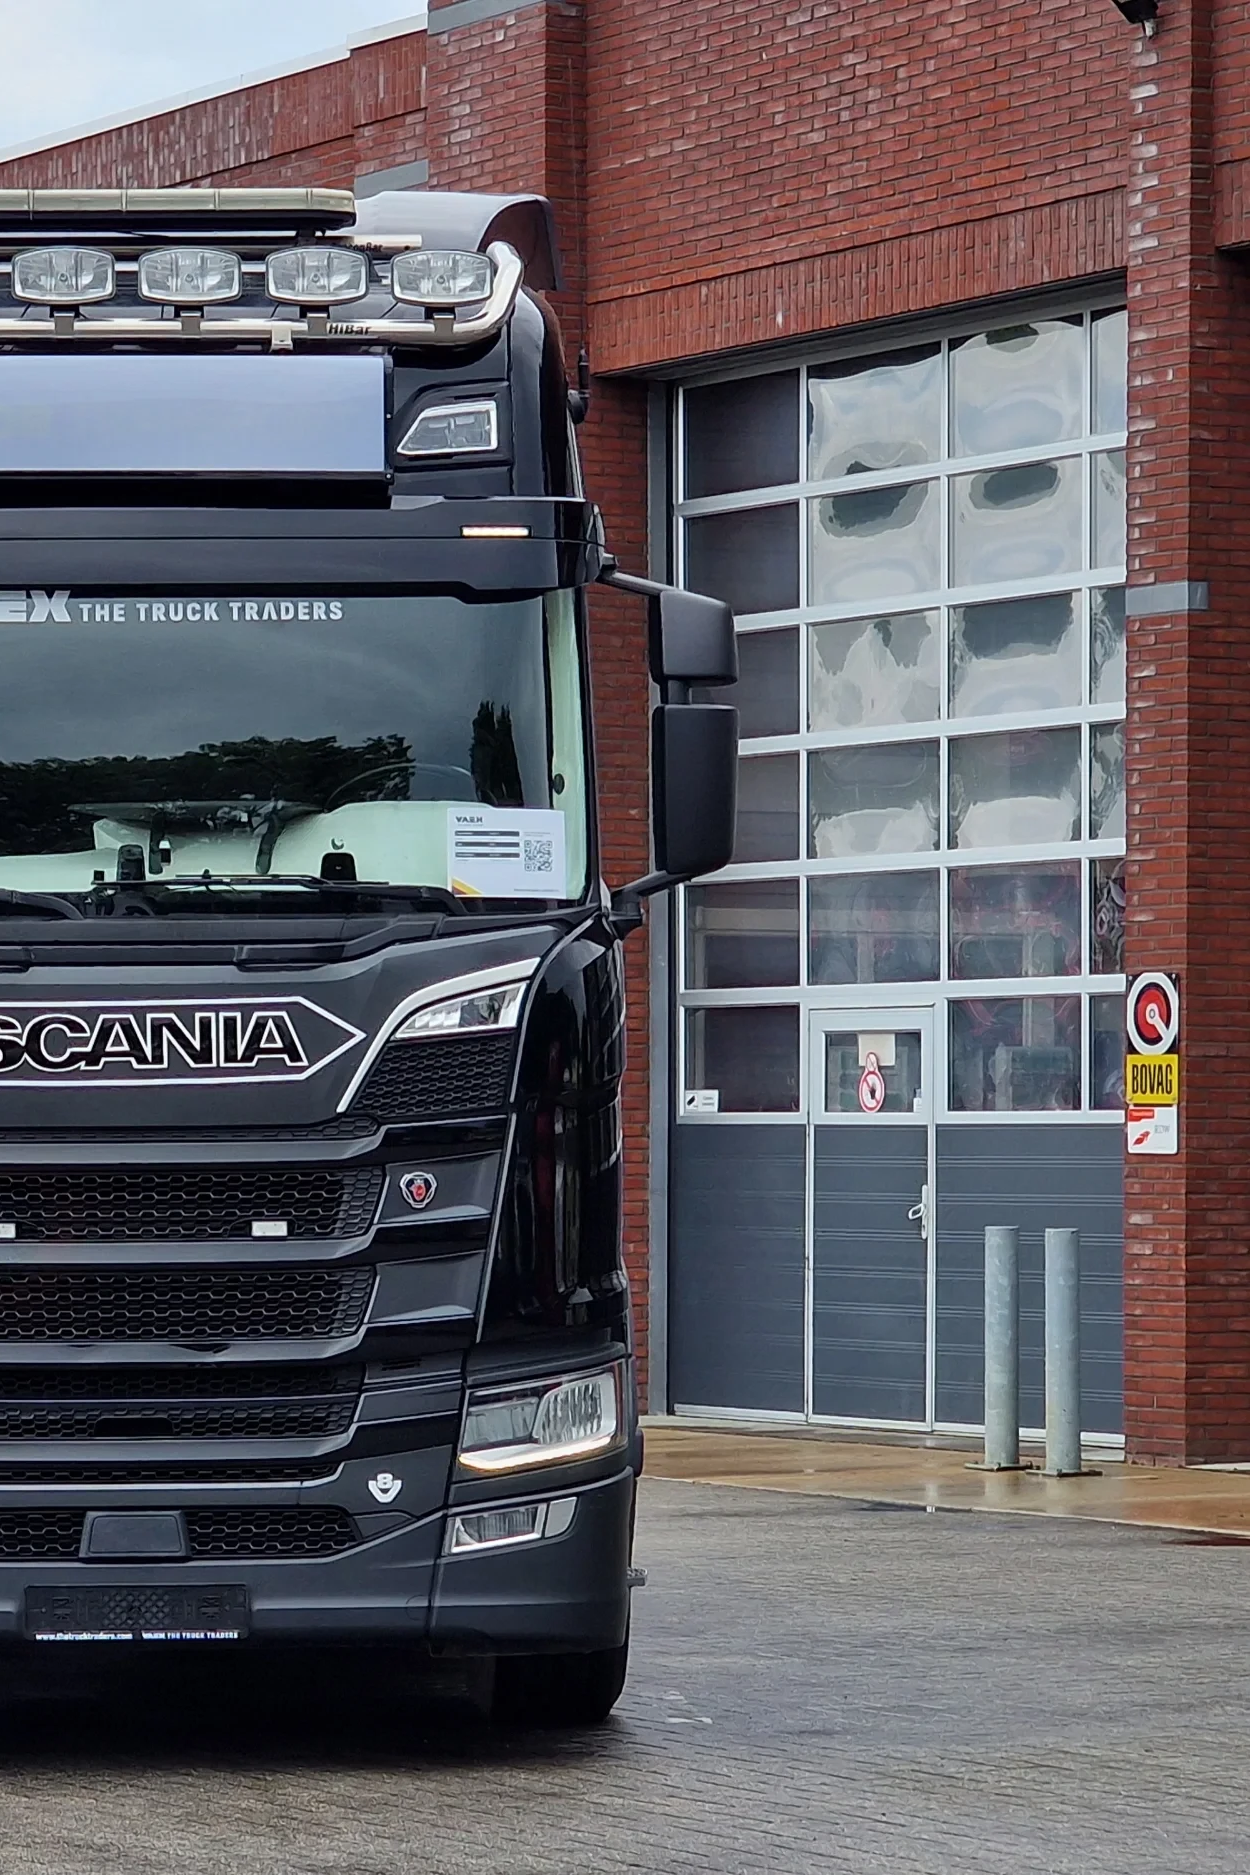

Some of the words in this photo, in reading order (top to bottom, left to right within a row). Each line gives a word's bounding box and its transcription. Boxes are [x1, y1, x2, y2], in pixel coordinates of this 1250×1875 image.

[329, 324, 372, 335] HiBar
[79, 603, 126, 622] THE
[136, 602, 220, 621] TRUCK
[229, 601, 343, 620] TRADERS
[1132, 1064, 1173, 1094] BOVAG
